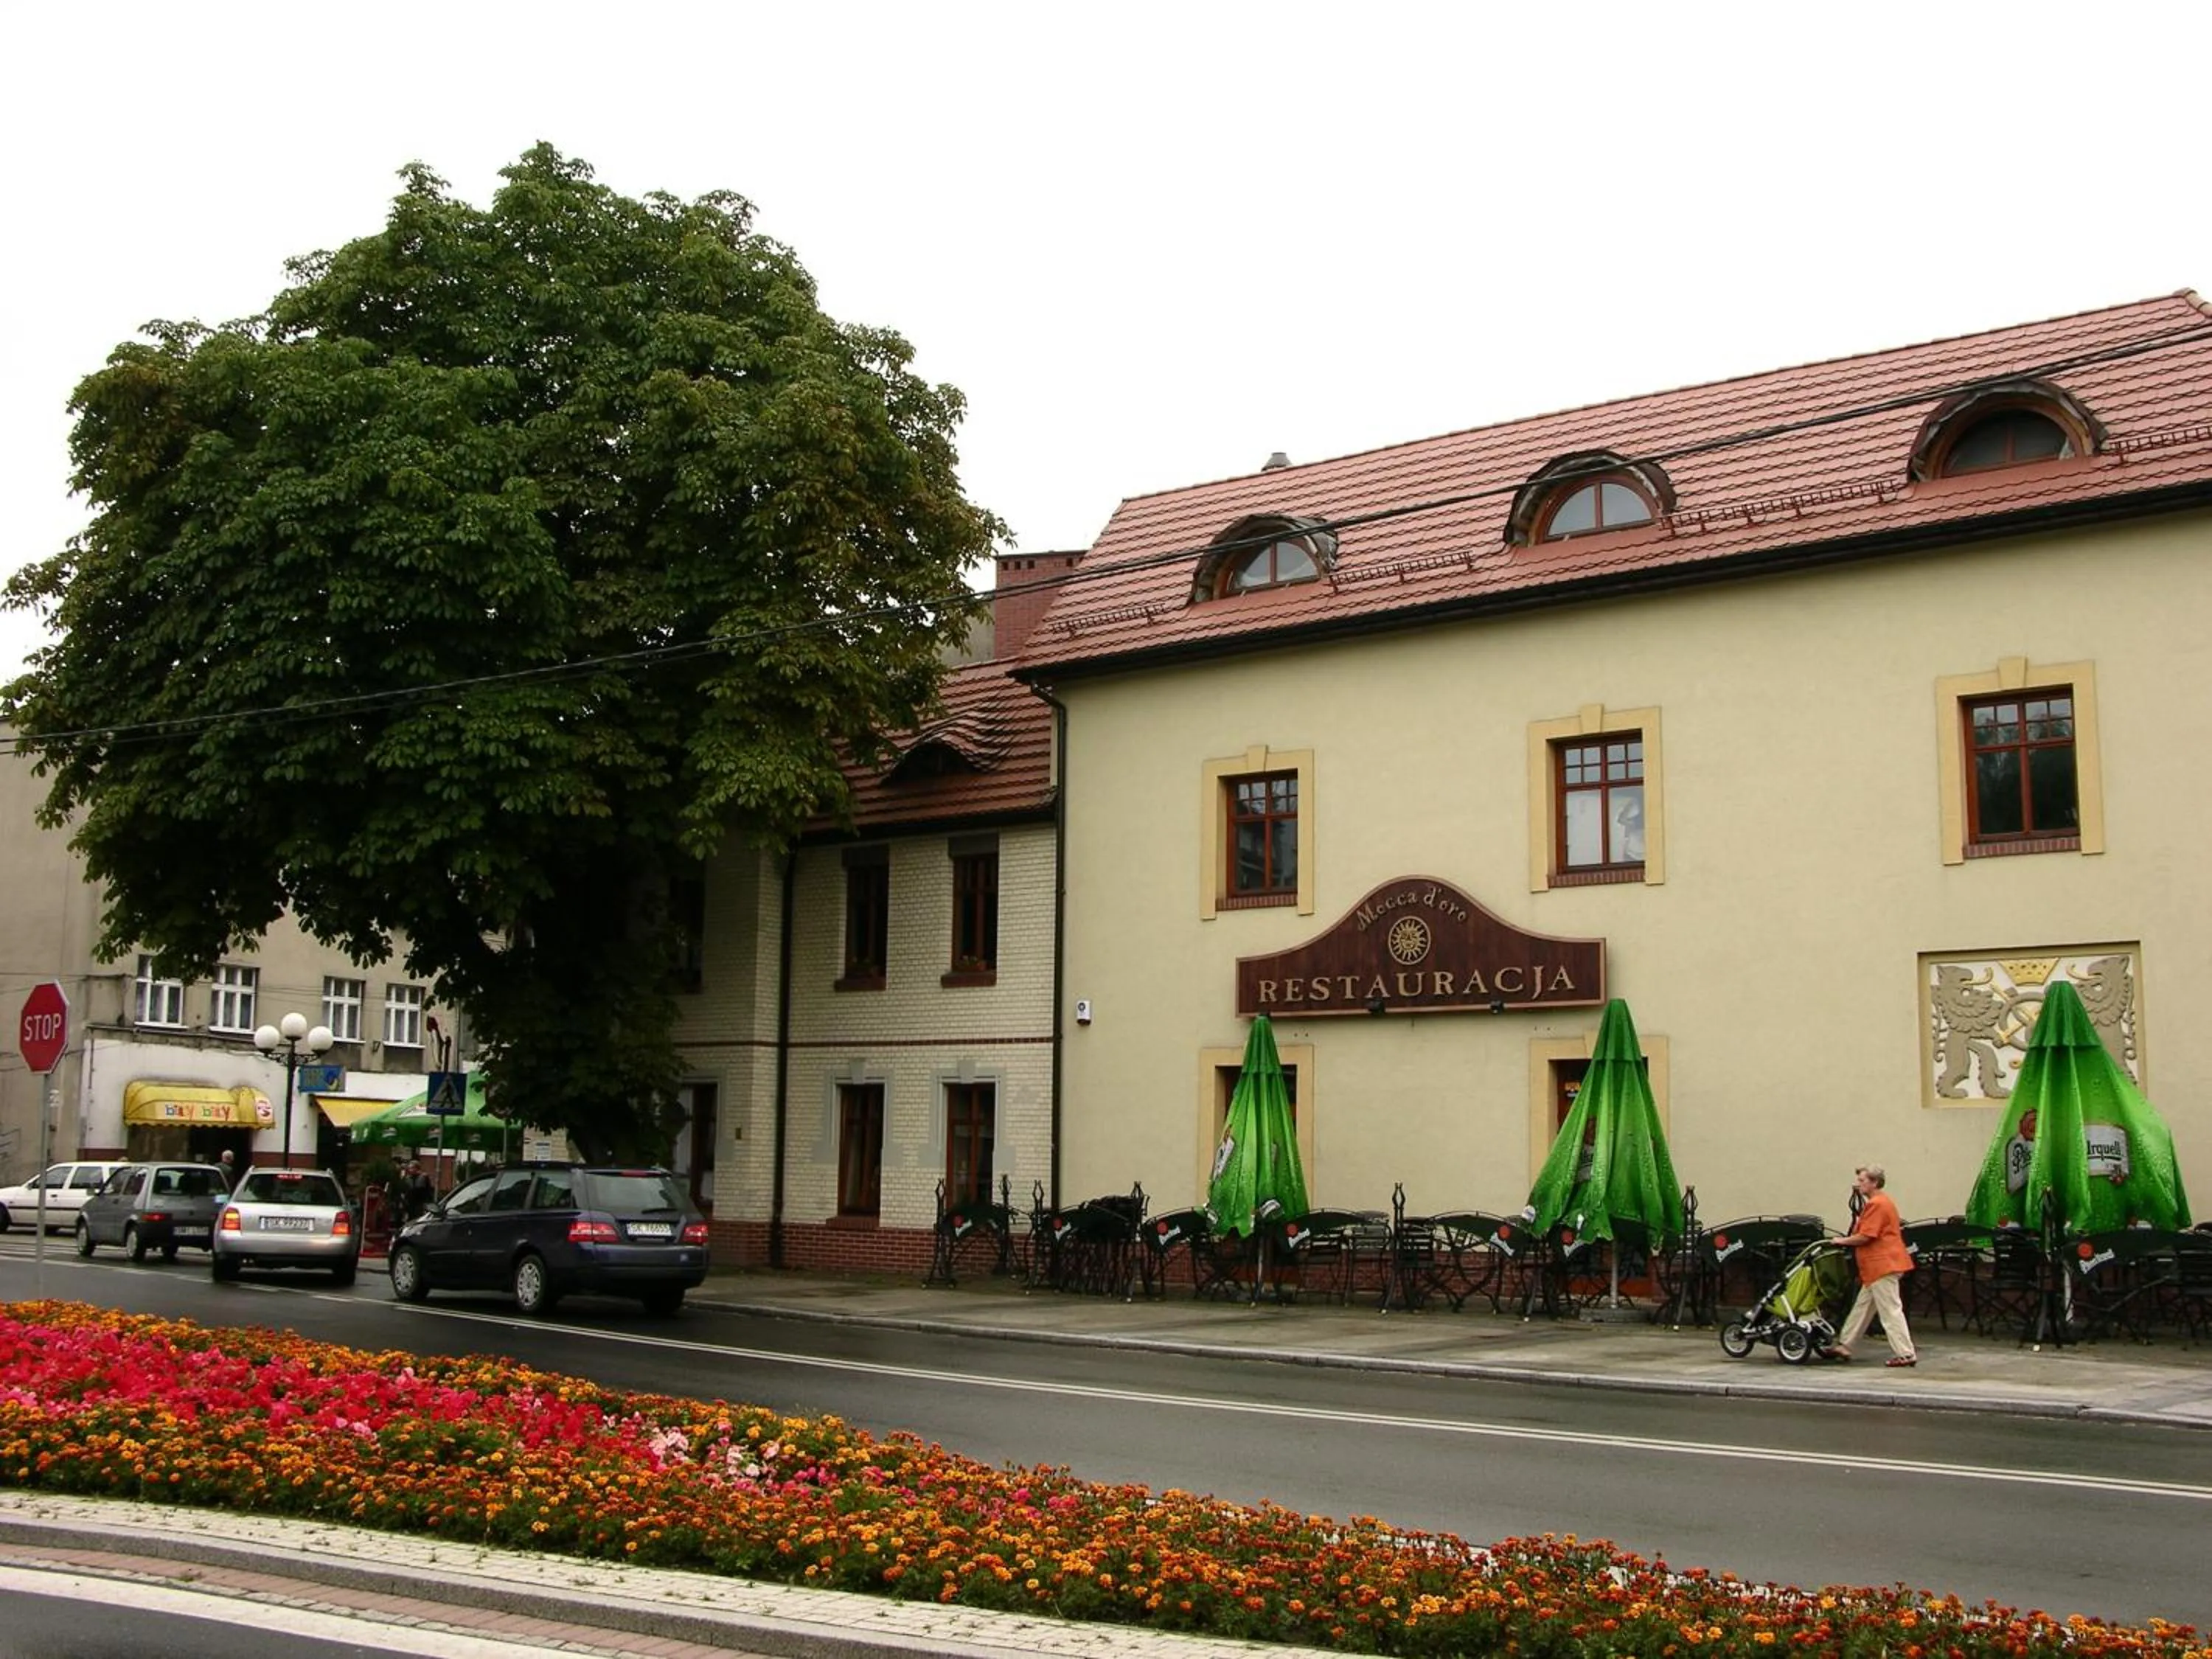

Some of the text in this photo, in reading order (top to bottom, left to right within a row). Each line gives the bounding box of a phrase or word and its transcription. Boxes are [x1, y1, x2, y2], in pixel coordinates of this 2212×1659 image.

[1357, 885, 1467, 931] Mocca d'oro
[1258, 965, 1576, 1004] RESTAURACJA
[23, 1012, 62, 1042] STOP
